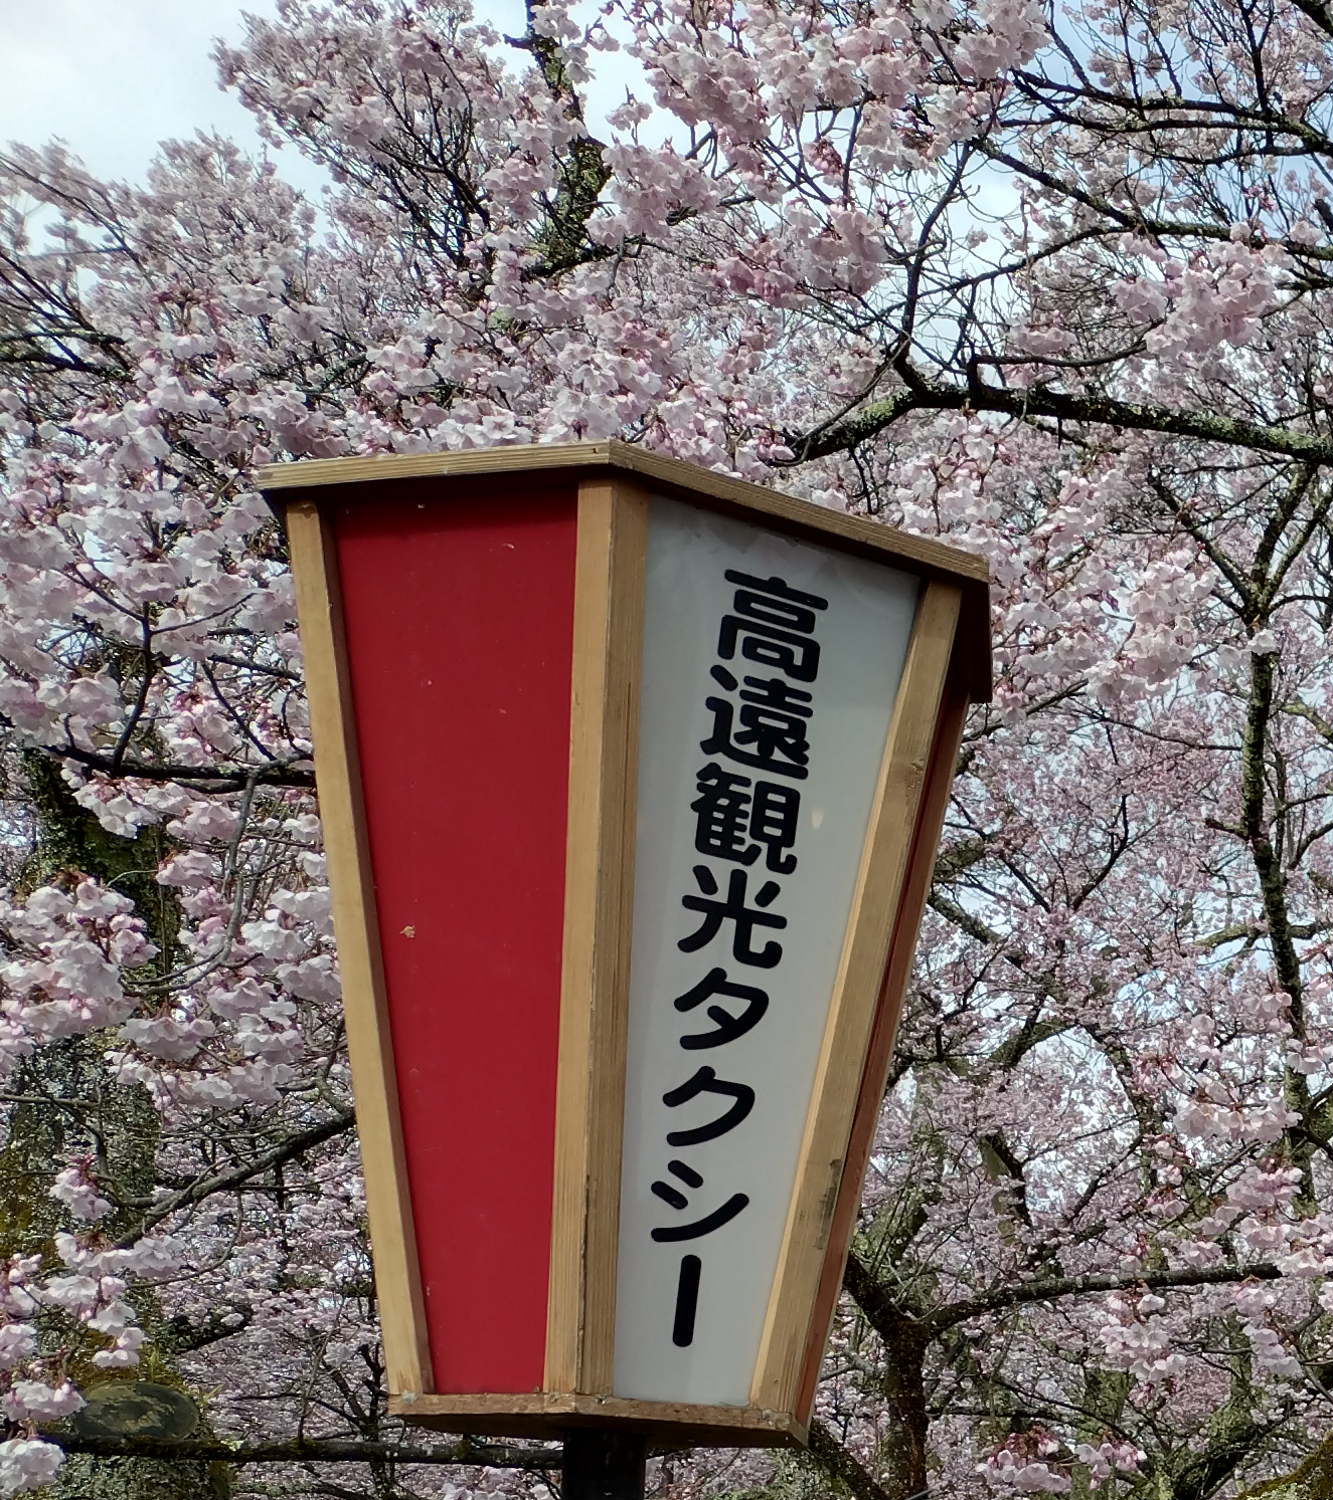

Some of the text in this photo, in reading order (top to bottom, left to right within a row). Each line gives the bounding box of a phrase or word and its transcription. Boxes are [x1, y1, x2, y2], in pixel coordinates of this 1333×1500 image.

[648, 567, 828, 1348] 高遠観光タクシー
